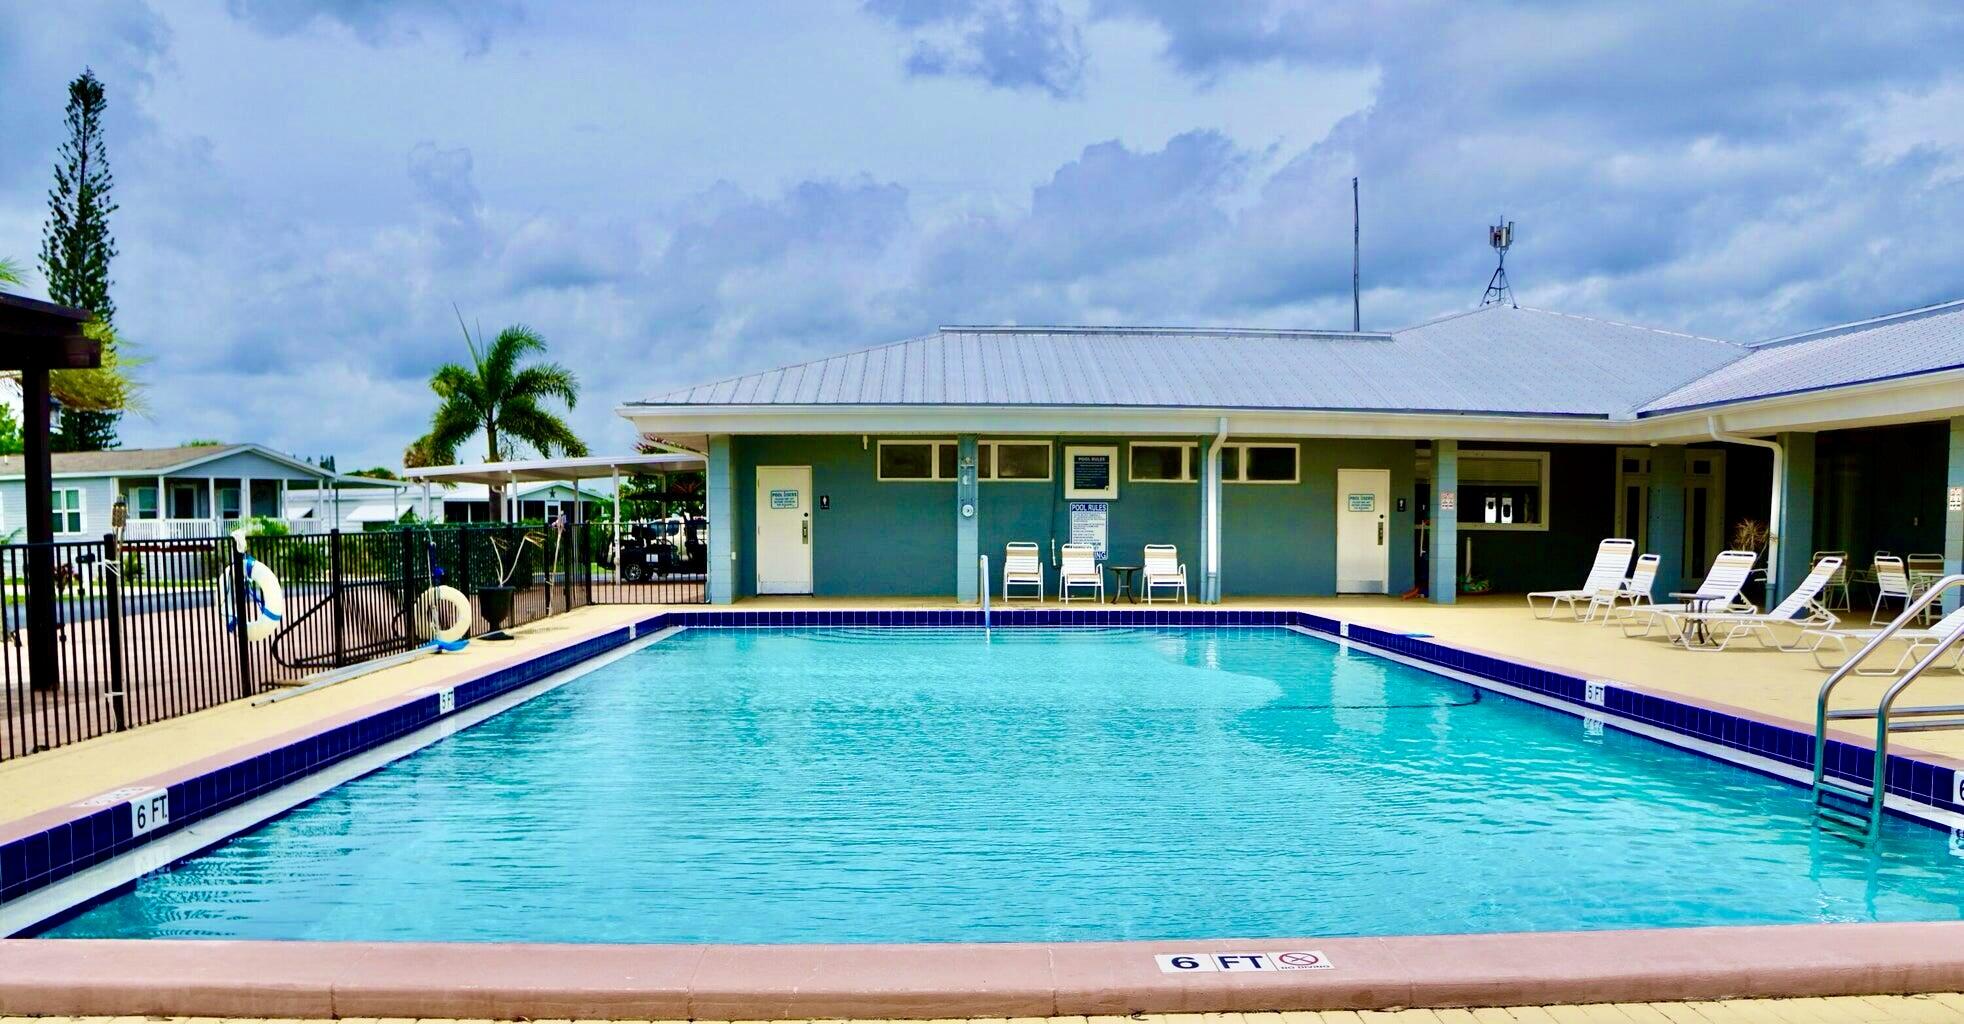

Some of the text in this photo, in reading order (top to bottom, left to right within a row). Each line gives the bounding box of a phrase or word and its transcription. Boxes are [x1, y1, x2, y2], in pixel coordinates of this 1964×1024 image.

[1588, 685, 1593, 700] 5
[137, 804, 147, 829] 6
[151, 794, 168, 823] FT.
[1171, 955, 1263, 970] 6 FT
